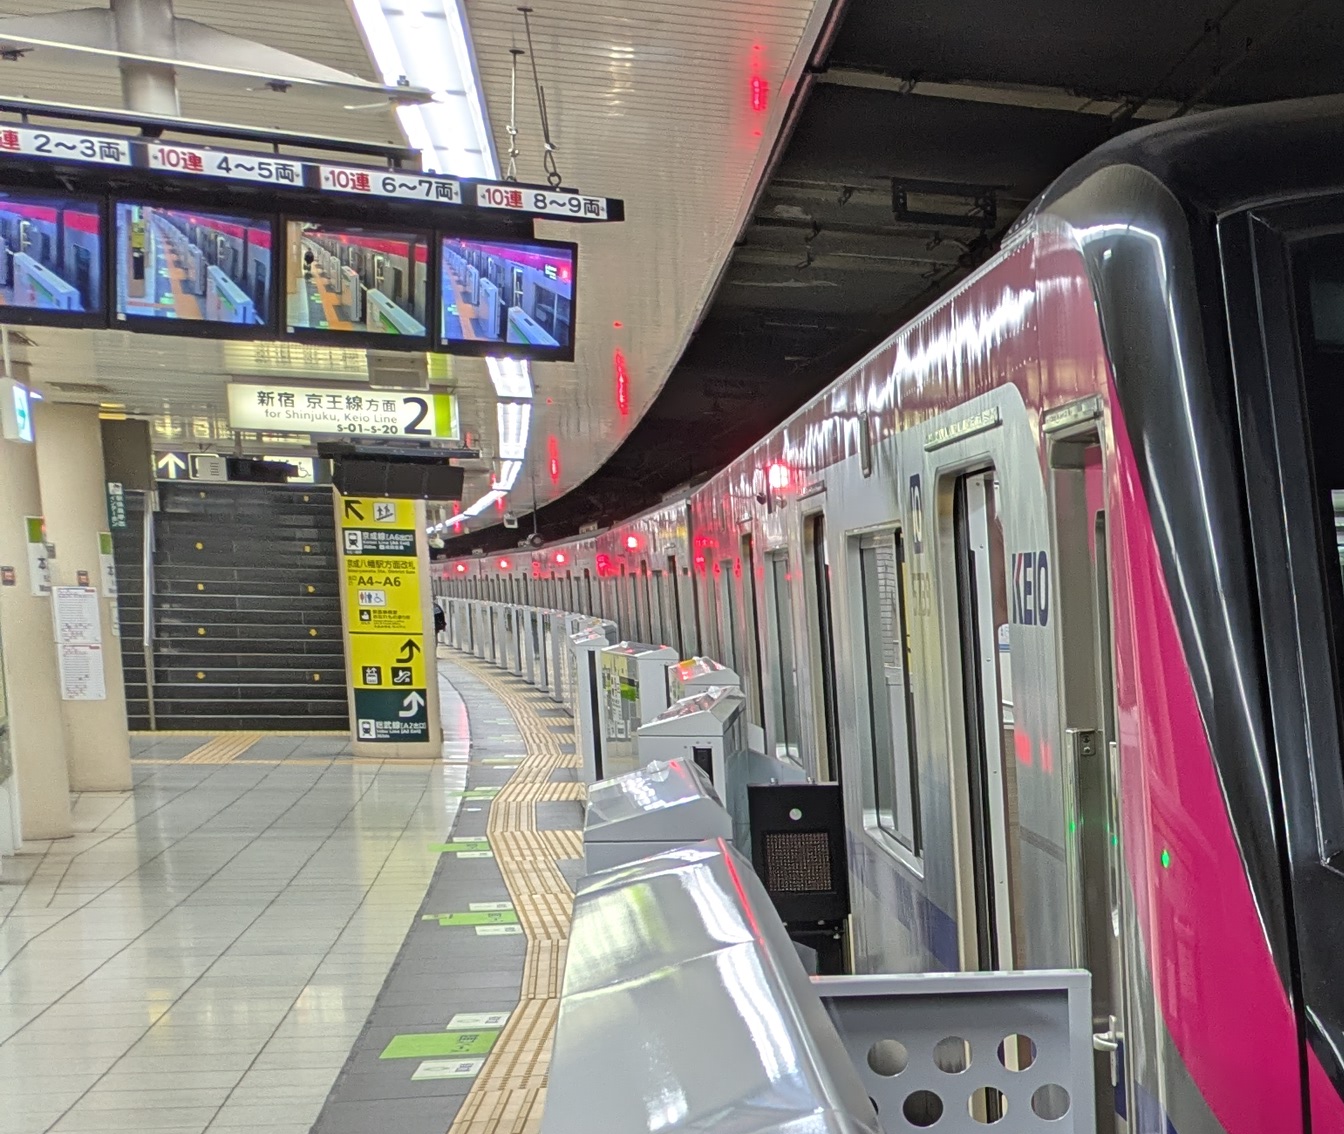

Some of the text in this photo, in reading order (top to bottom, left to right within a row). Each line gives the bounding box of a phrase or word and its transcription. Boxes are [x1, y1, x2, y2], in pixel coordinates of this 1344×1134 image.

[158, 148, 204, 172] 10連
[329, 169, 371, 192] 10連
[485, 188, 523, 209] 10連
[257, 391, 397, 413] 新宿 京王線方面
[265, 409, 398, 424] for Shinjuku, Keio Line
[402, 396, 432, 435] 2
[1012, 550, 1049, 626] KEIO
